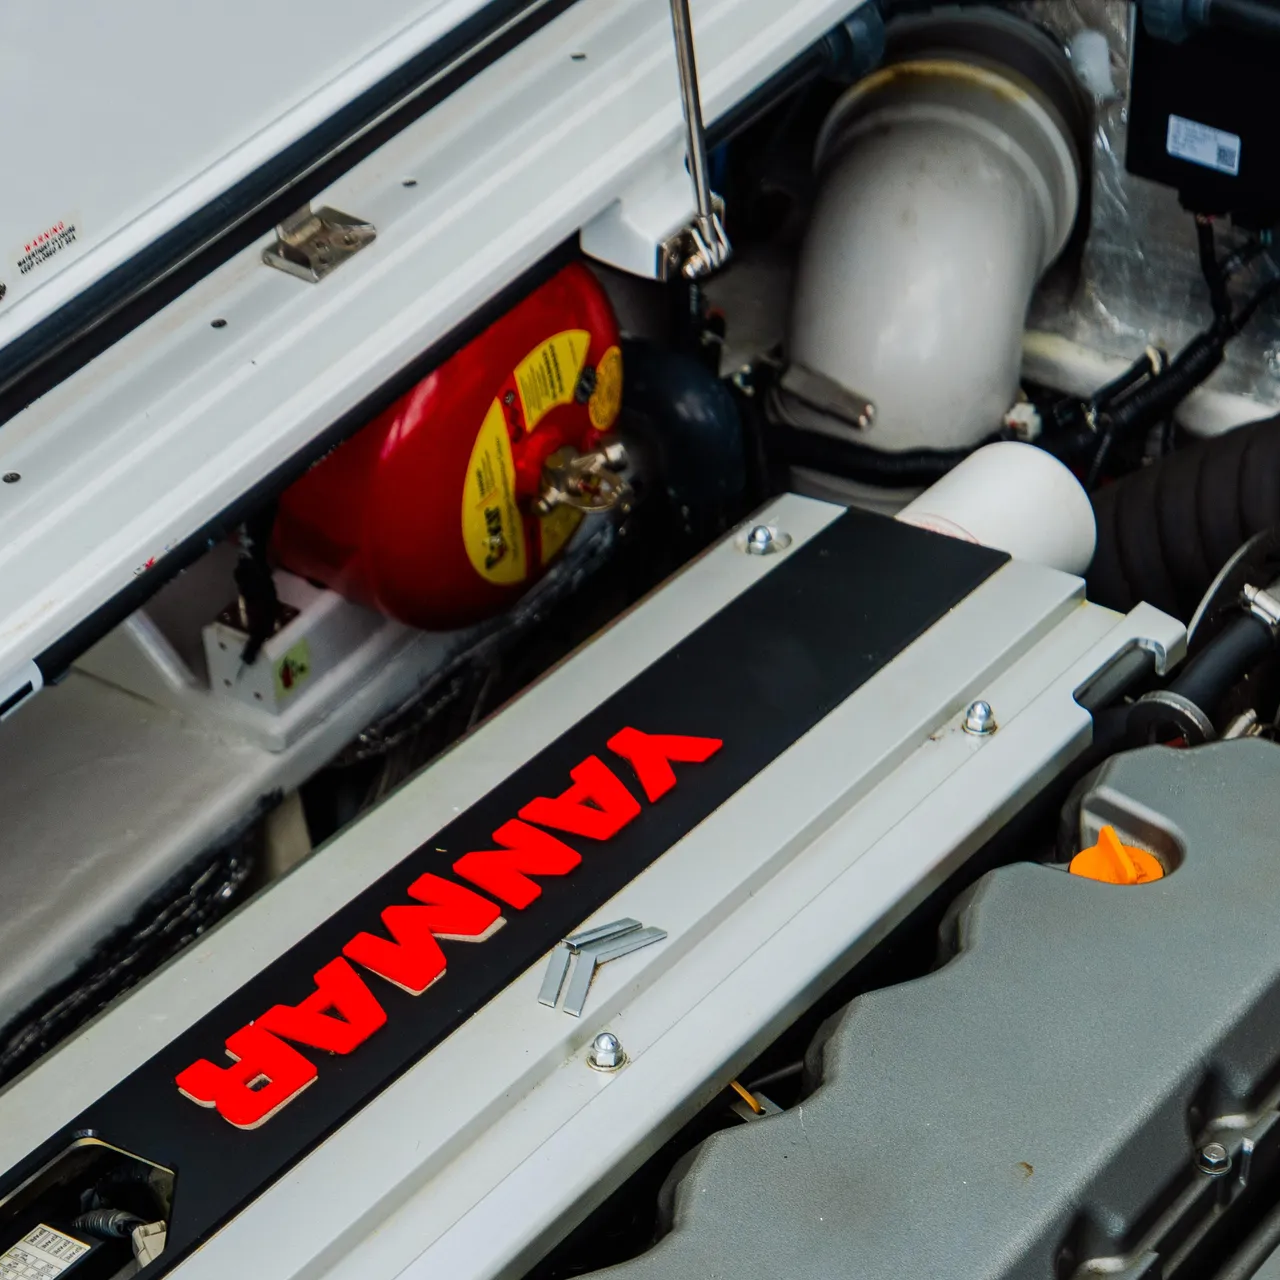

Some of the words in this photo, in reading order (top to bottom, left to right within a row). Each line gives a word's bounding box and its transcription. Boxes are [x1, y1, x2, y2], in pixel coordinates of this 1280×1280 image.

[24, 221, 64, 252] WARNING
[175, 727, 723, 1129] YANMAR
[29, 1228, 46, 1242] SPARE
[41, 1234, 58, 1248] SPARE
[53, 1240, 70, 1254] SPARE
[65, 1246, 82, 1260] SPARE
